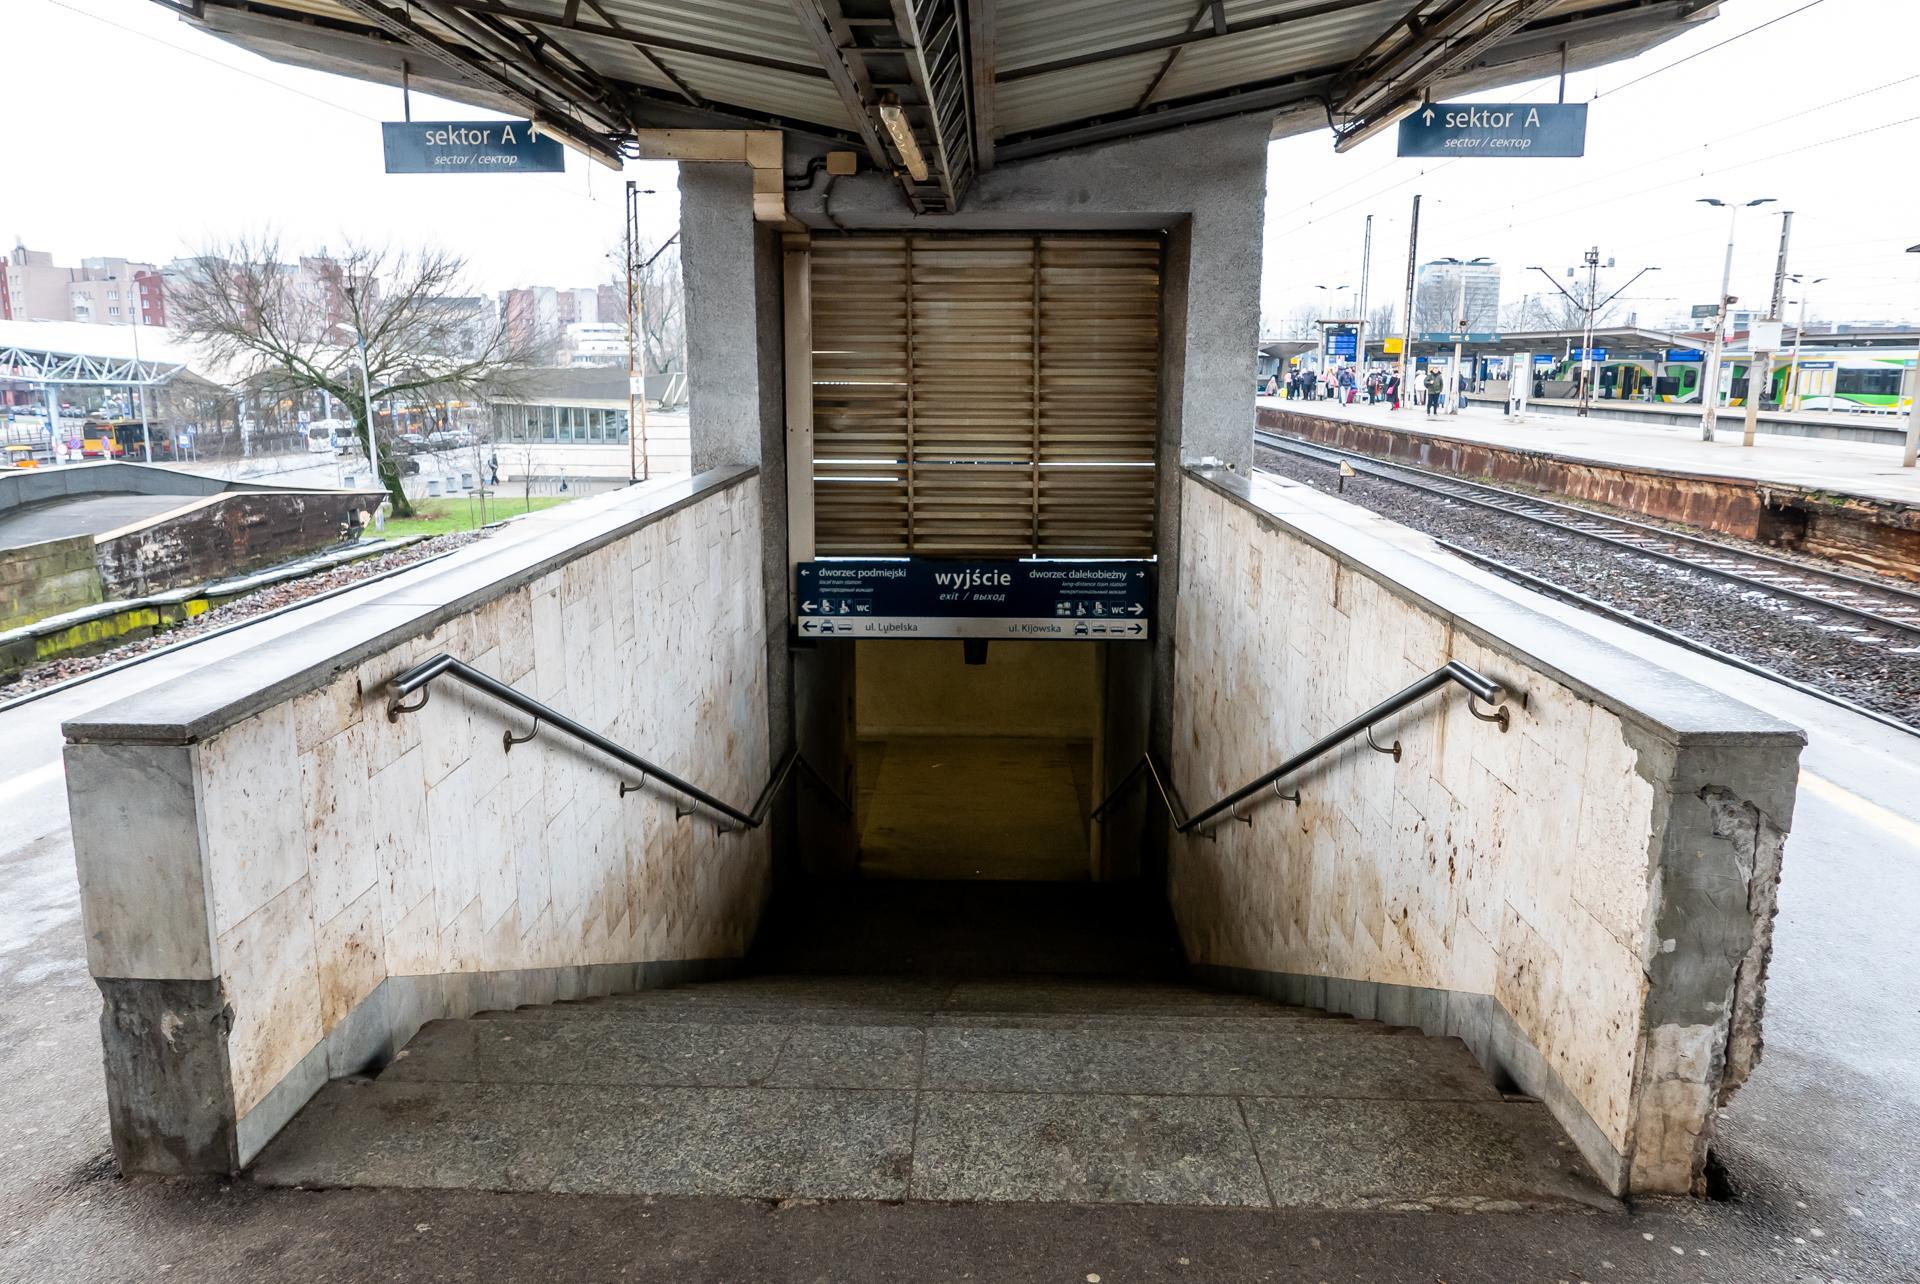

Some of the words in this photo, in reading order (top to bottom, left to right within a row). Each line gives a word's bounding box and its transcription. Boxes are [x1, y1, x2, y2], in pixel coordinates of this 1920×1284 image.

[1445, 107, 1514, 128] sektor
[1524, 107, 1541, 127] A
[425, 125, 490, 145] sektor
[501, 125, 516, 145] A
[1444, 137, 1482, 148] sector
[1490, 138, 1532, 149] сектор
[434, 154, 470, 165] sector
[478, 155, 518, 166] сектор
[819, 568, 856, 577] dworzec
[858, 568, 907, 579] podmiejski
[1029, 569, 1067, 579] dworzec
[1068, 569, 1127, 581] dalekobieżny
[935, 569, 1012, 590] wyjście
[939, 592, 959, 601] exit
[963, 592, 970, 601] /
[973, 593, 1006, 602] выход
[856, 604, 870, 612] WC
[1111, 605, 1125, 614] WC
[865, 623, 875, 631] ul.
[1009, 624, 1020, 633] ul.
[1022, 624, 1062, 634] Kijowska
